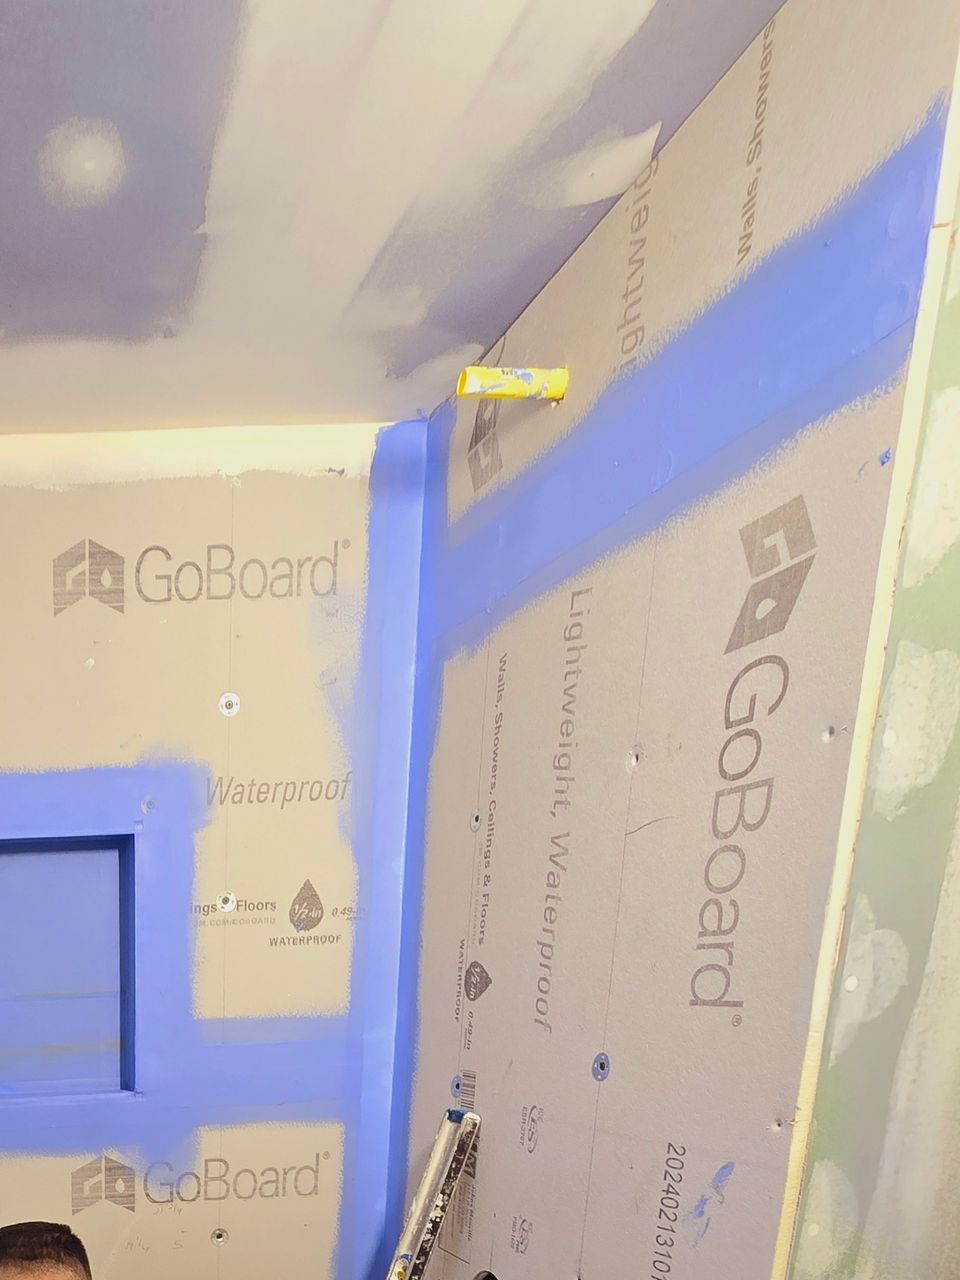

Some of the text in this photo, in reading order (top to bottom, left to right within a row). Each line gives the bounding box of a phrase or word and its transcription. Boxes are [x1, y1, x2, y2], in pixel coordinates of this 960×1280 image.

[613, 156, 659, 374] ightweig
[206, 771, 353, 809] Waterproof
[548, 586, 593, 824] Lightweight,
[269, 934, 342, 947] WATERPROOF
[534, 831, 572, 1033] Waterproof
